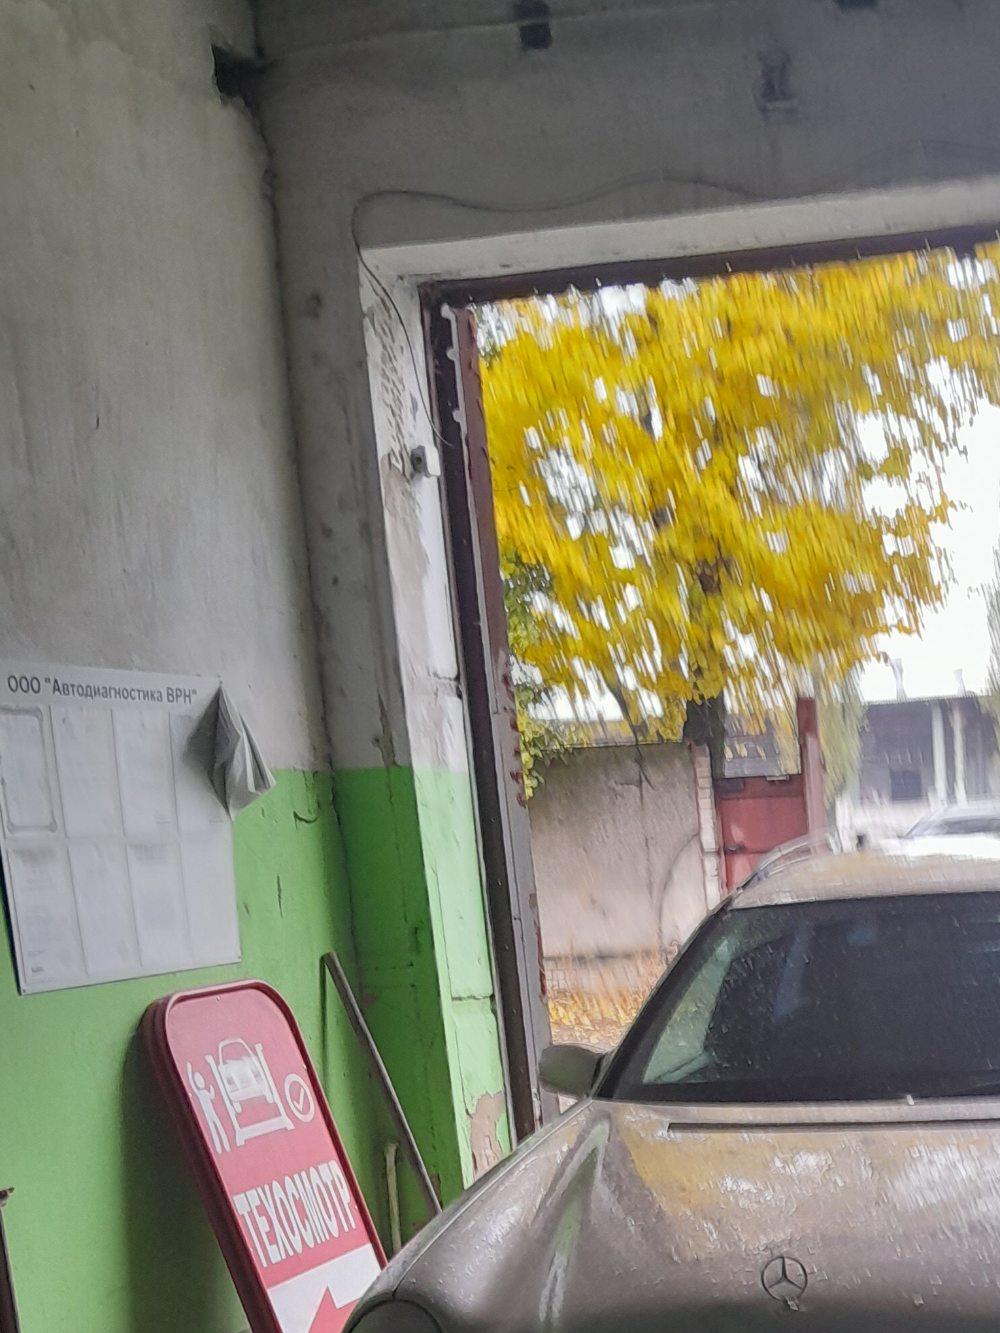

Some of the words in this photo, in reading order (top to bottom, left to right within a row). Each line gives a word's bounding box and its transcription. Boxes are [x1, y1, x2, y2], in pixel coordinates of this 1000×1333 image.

[8, 675, 41, 694] ООО
[45, 677, 163, 703] "Автодиагностика
[166, 686, 198, 704] ВРН"
[233, 1160, 356, 1268] ТЕХОСМОТР
